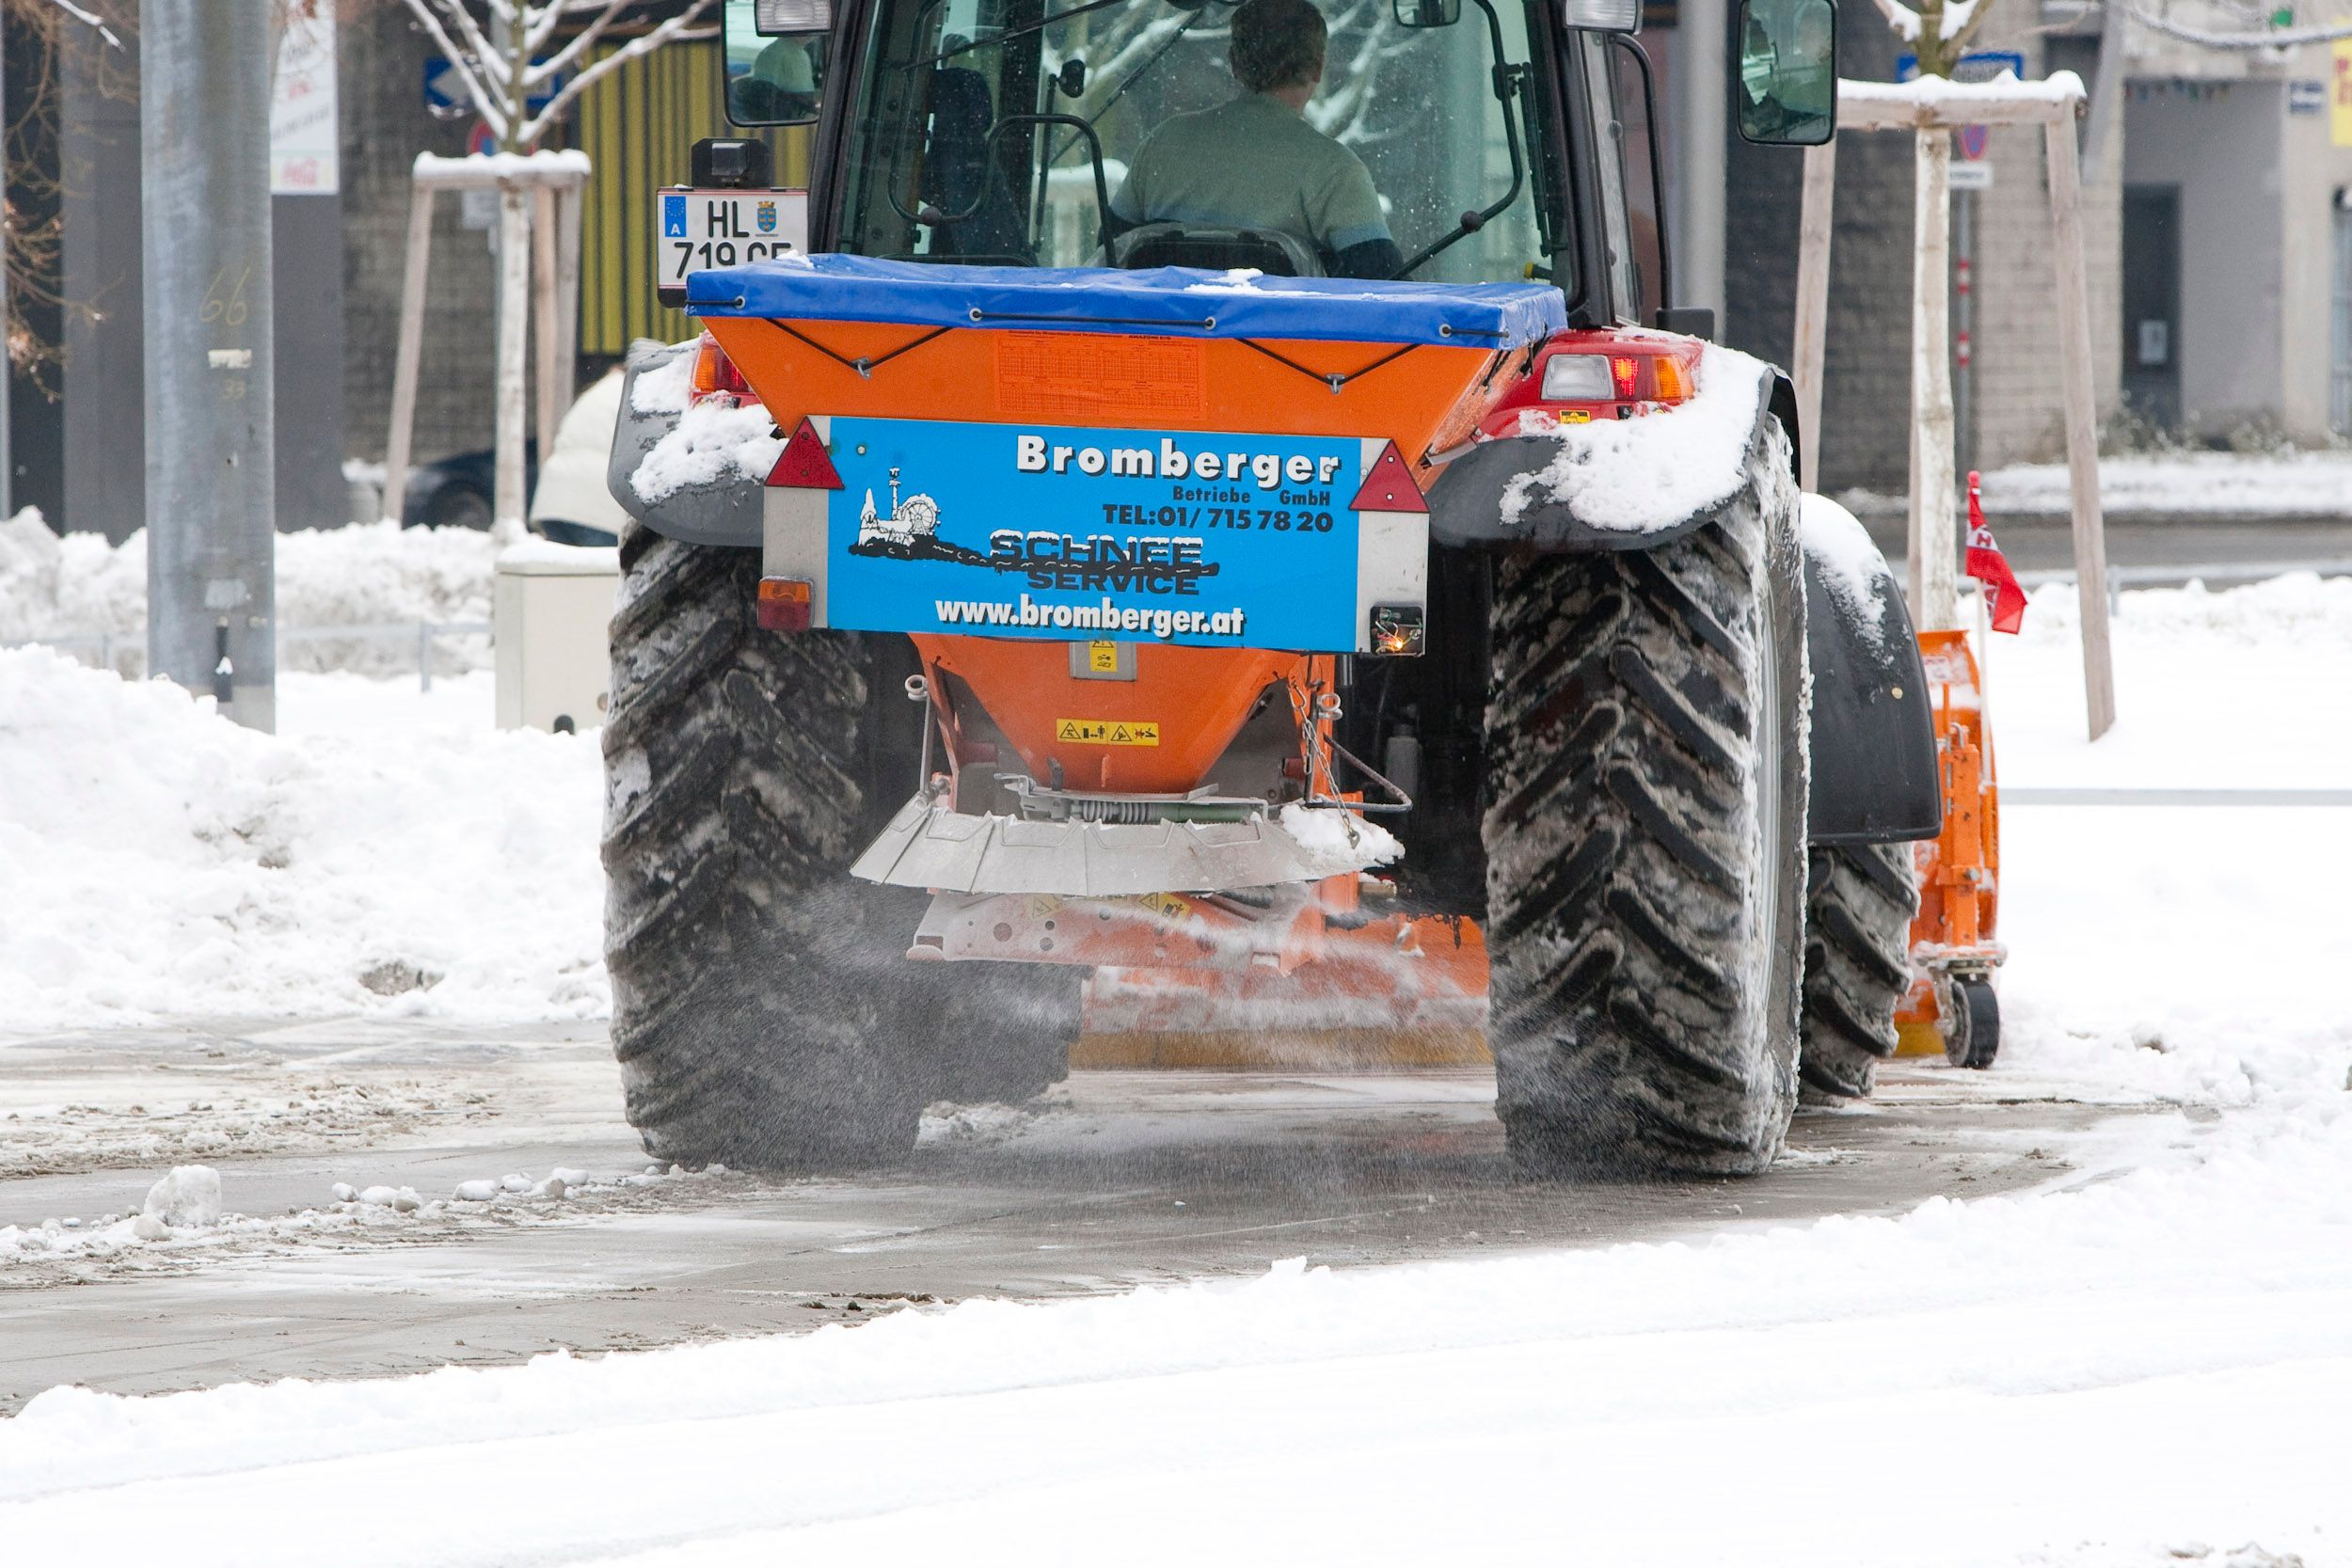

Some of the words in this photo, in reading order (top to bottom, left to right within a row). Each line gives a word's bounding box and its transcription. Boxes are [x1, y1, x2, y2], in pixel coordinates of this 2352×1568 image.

[670, 223, 681, 235] A
[707, 200, 750, 238] HL
[674, 242, 736, 279] 719
[1016, 435, 1340, 490] Bromberger
[1172, 485, 1251, 504] Betriebe
[1279, 489, 1331, 507] GmbH
[1208, 508, 1251, 530] 715
[1258, 511, 1293, 531] 78
[1296, 513, 1334, 532] 20
[990, 529, 1203, 571] SCHNEE
[1027, 568, 1200, 595] SERVICE
[935, 594, 1247, 638] www.bromberger.at
